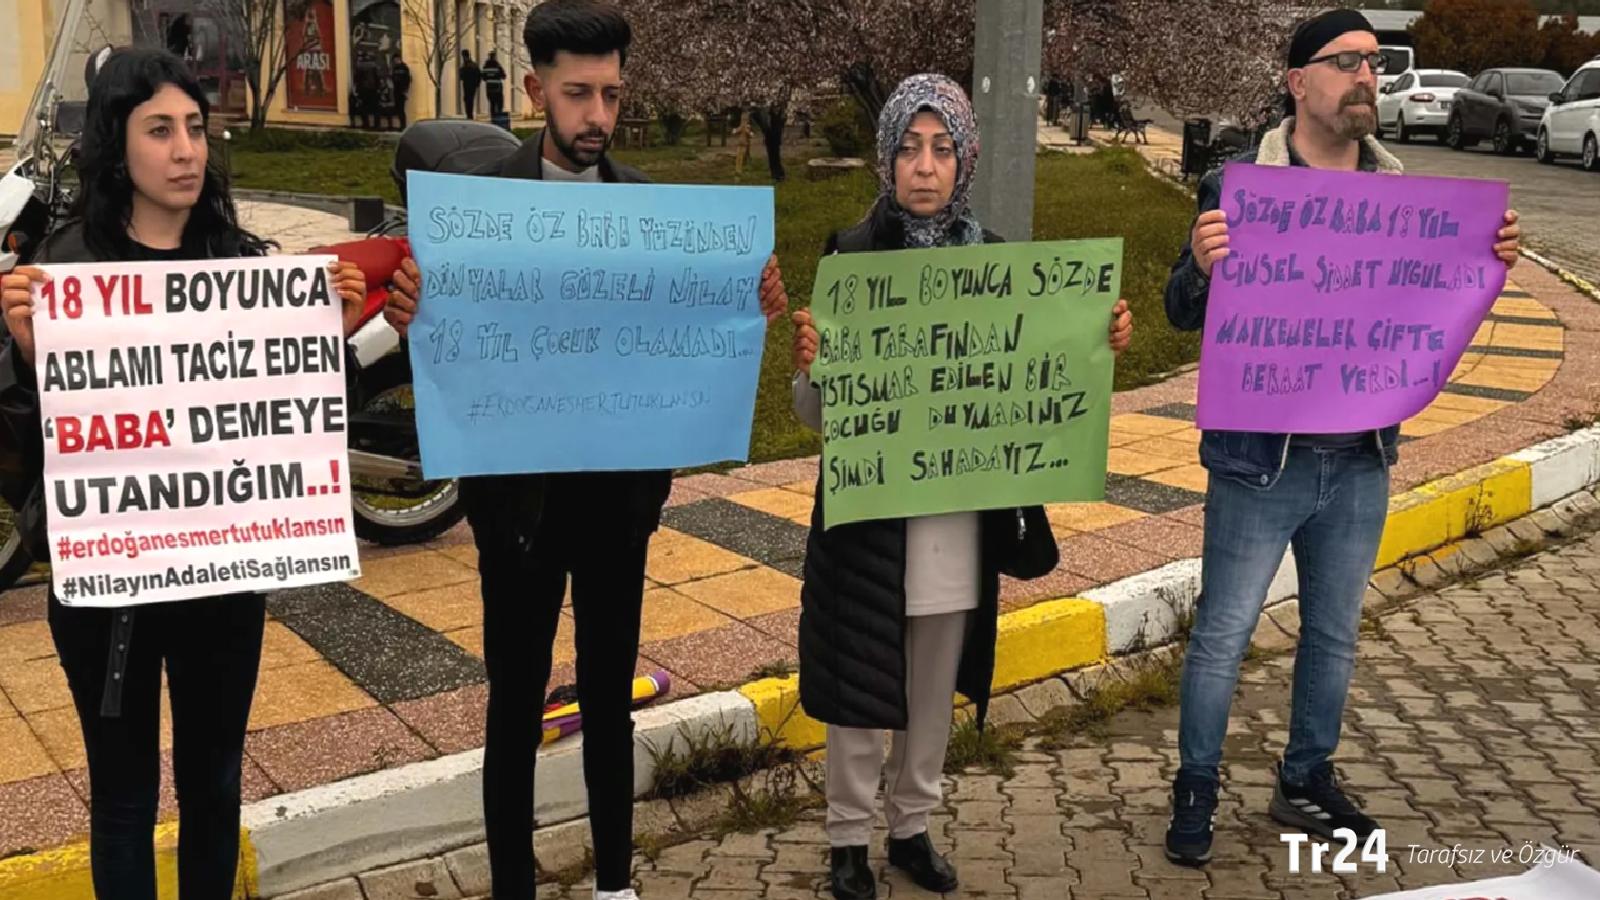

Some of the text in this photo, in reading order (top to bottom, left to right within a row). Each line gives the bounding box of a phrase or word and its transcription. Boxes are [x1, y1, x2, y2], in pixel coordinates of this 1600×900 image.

[427, 205, 513, 243] SÖZDE
[526, 207, 565, 243] ÖZ
[1299, 193, 1328, 229] ÖZ
[41, 267, 331, 320] 18 YIL BOYUNCA
[827, 256, 1114, 315] 18 YIL BOYUNCA SÖZDE
[429, 318, 464, 364] 18
[871, 313, 1024, 361] TARAFINDAN
[44, 330, 341, 392] ABLAMI TACİZ EDEN
[930, 361, 1014, 393] EDİLEN
[1025, 352, 1072, 392] BİR
[188, 397, 345, 444] DEMEYE
[928, 390, 1089, 431] DUYMADINIZ
[829, 450, 885, 495] ŞİMDİ
[57, 517, 346, 561] #erdoğanesmertutuklansın
